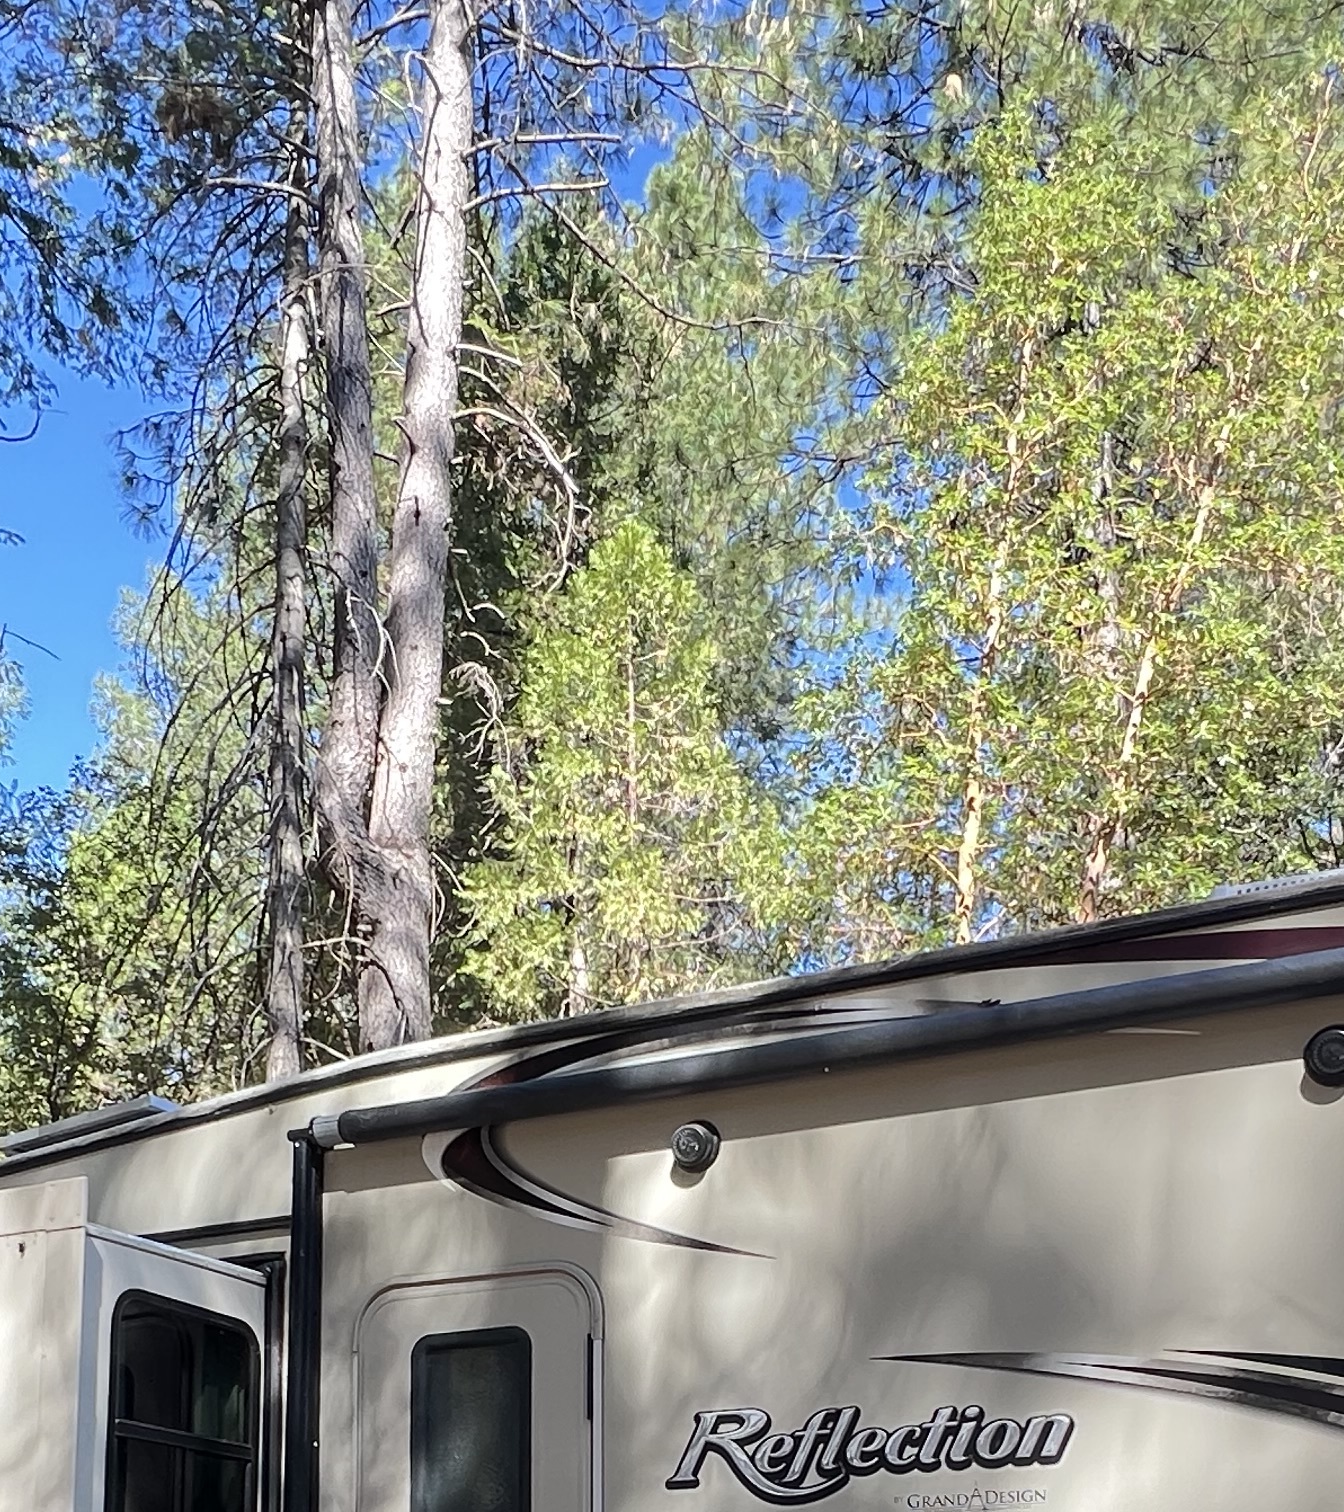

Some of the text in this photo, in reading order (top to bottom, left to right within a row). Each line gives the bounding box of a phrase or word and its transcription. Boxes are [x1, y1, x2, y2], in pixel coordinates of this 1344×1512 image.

[665, 1405, 1075, 1505] Reflection
[907, 1493, 969, 1509] GRAND
[985, 1489, 1047, 1504] DESIGN
